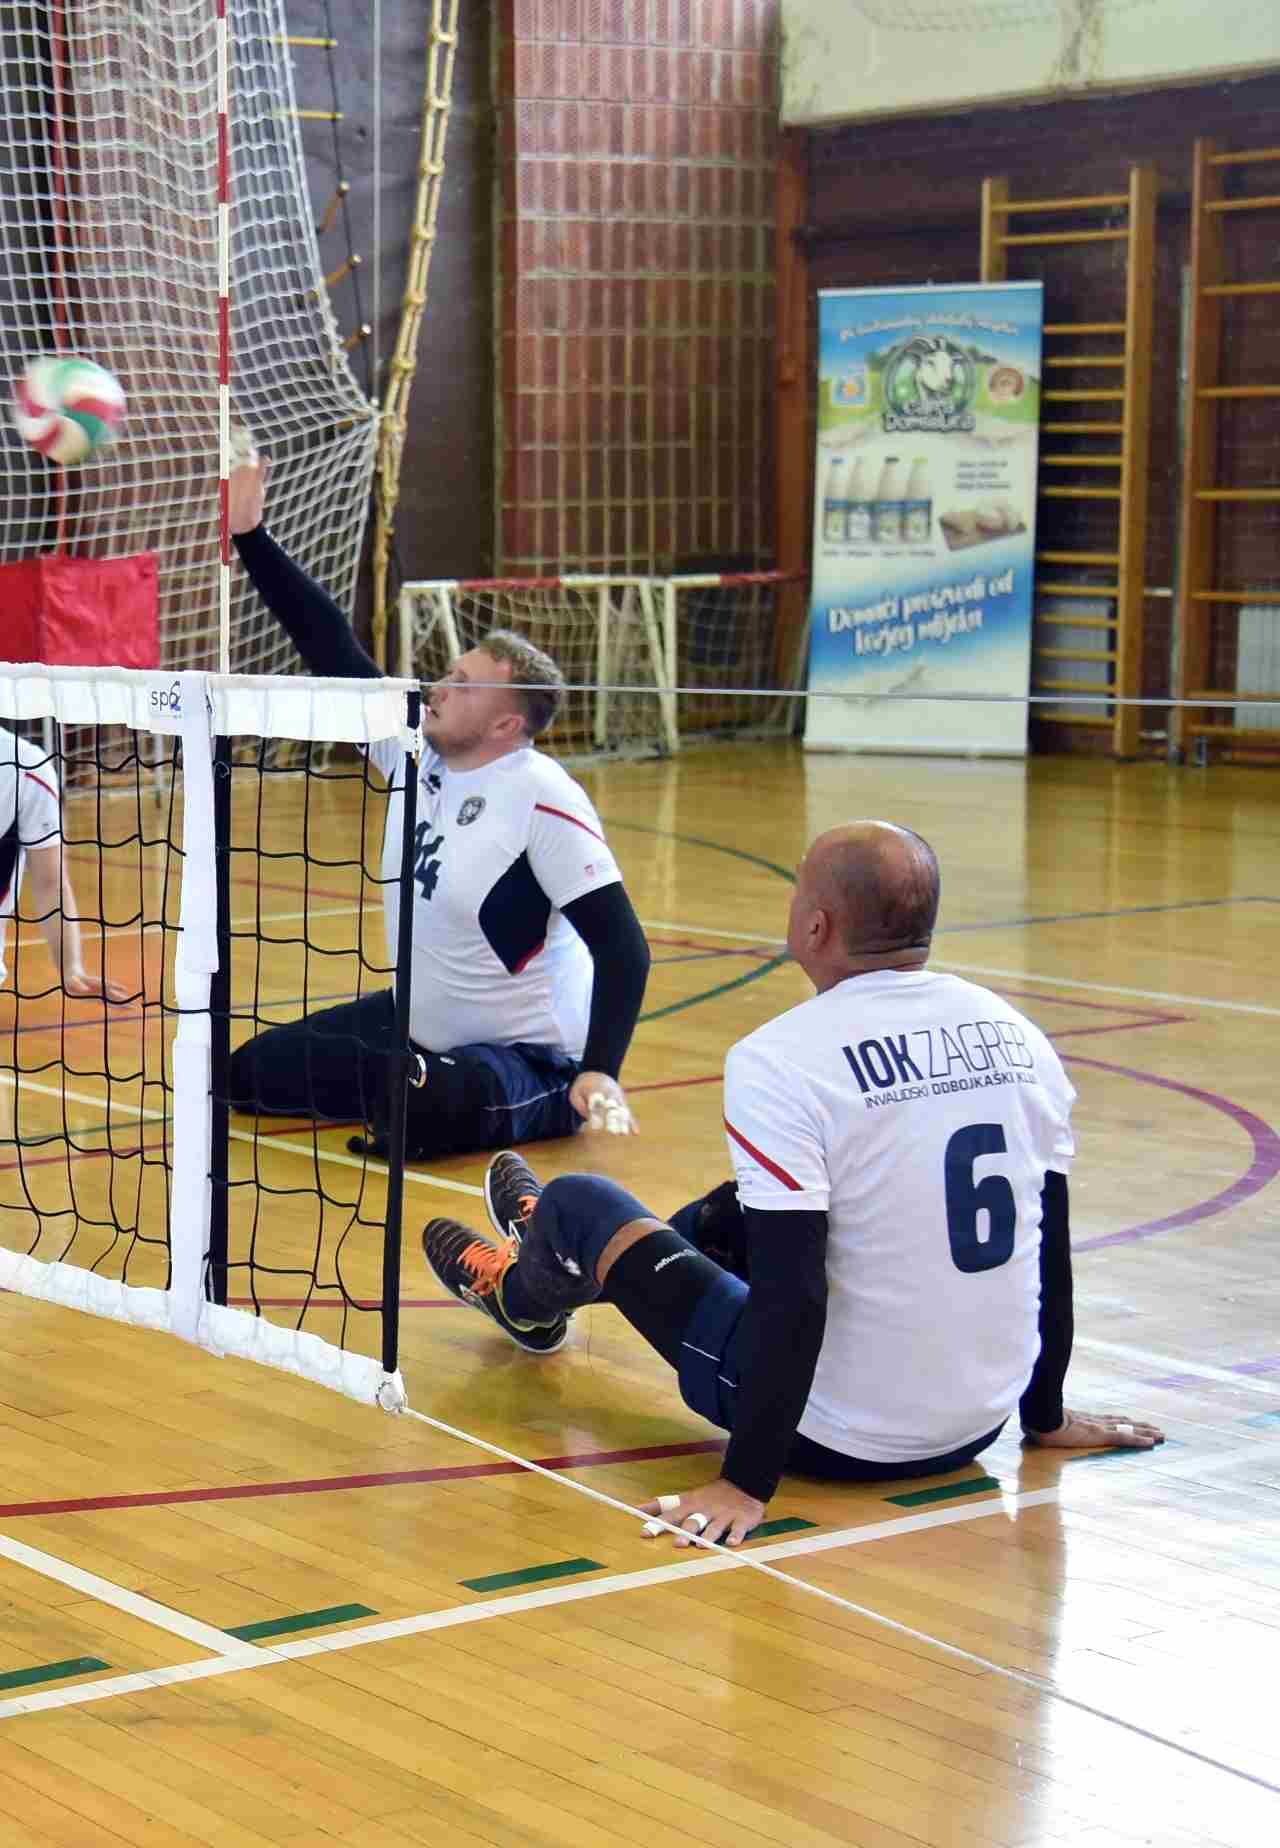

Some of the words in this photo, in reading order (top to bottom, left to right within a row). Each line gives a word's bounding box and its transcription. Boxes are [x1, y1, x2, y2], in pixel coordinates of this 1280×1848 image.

[841, 1034, 924, 1093] IOK
[912, 1020, 1035, 1079] ZAGREB
[864, 1083, 929, 1109] INVALIDSKI
[931, 1069, 1015, 1096] ODBOJKAŠKI
[944, 1122, 1017, 1274] 6
